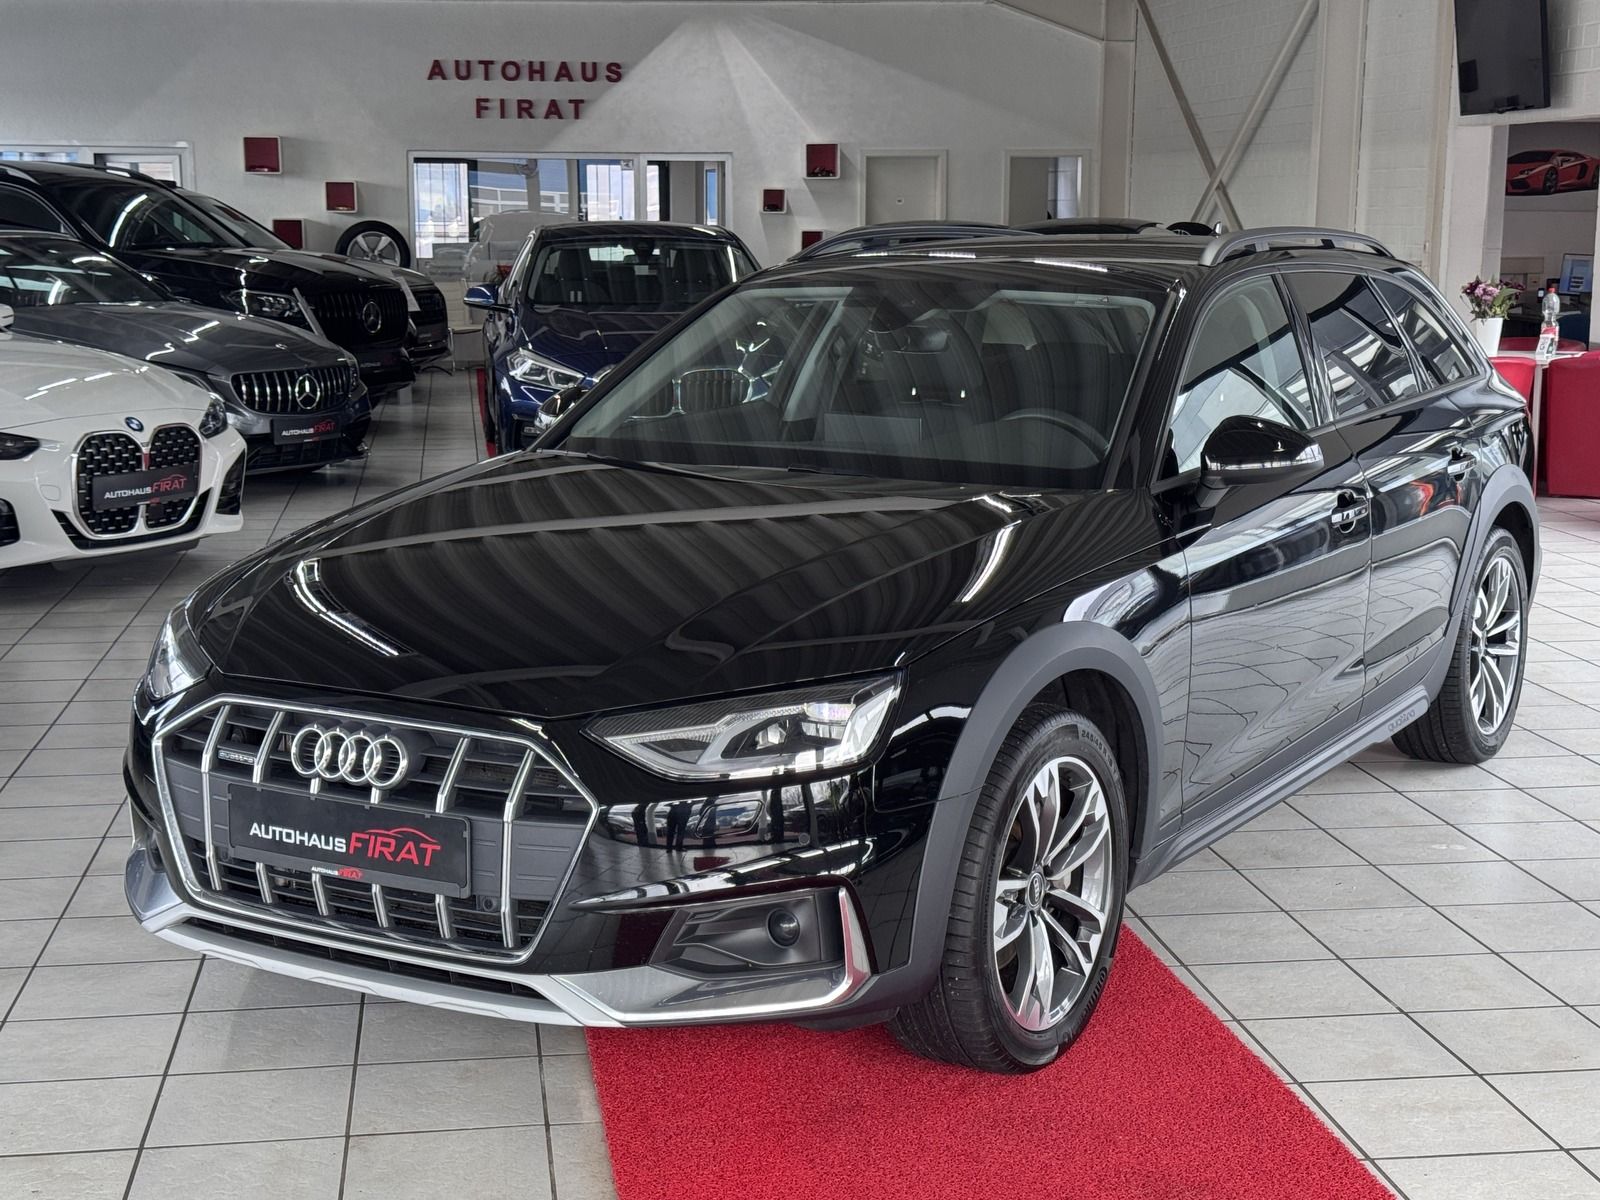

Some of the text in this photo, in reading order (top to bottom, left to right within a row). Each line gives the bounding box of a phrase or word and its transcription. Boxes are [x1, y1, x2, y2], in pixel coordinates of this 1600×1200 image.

[427, 59, 623, 83] AUTOHAUS
[475, 97, 585, 120] FIRAT
[104, 478, 187, 499] AUTOHAUS FIRAT
[250, 822, 442, 867] AUTOHAUS FIRAT
